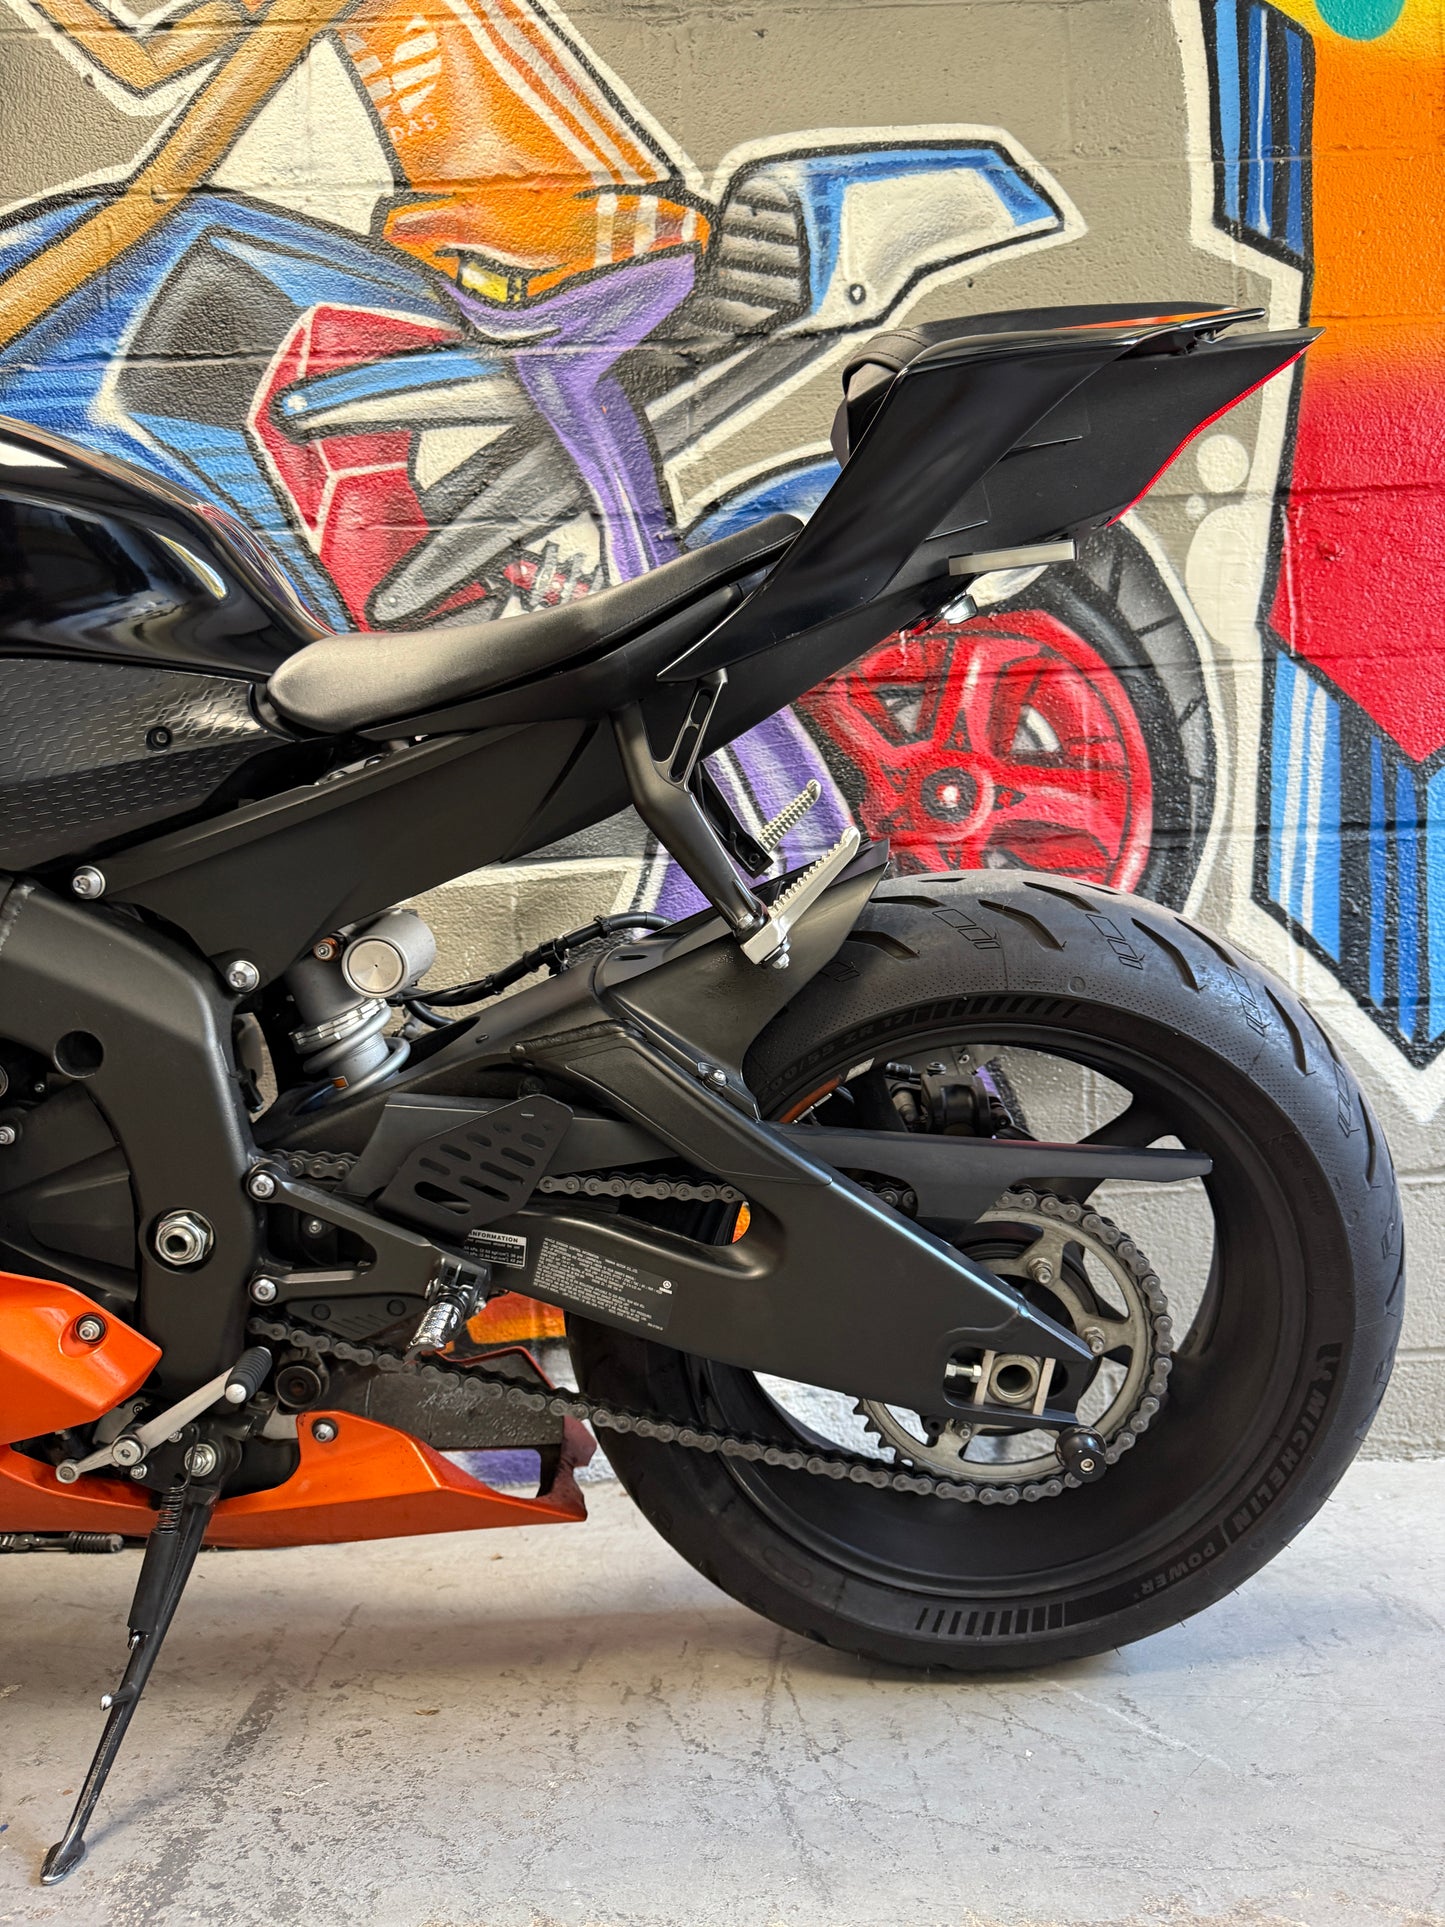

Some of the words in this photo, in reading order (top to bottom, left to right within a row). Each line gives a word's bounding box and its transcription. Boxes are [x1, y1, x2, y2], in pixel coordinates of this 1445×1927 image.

[389, 113, 438, 142] DAS
[1232, 1394, 1328, 1532] MICHELIN
[1140, 1544, 1217, 1595] POWER
